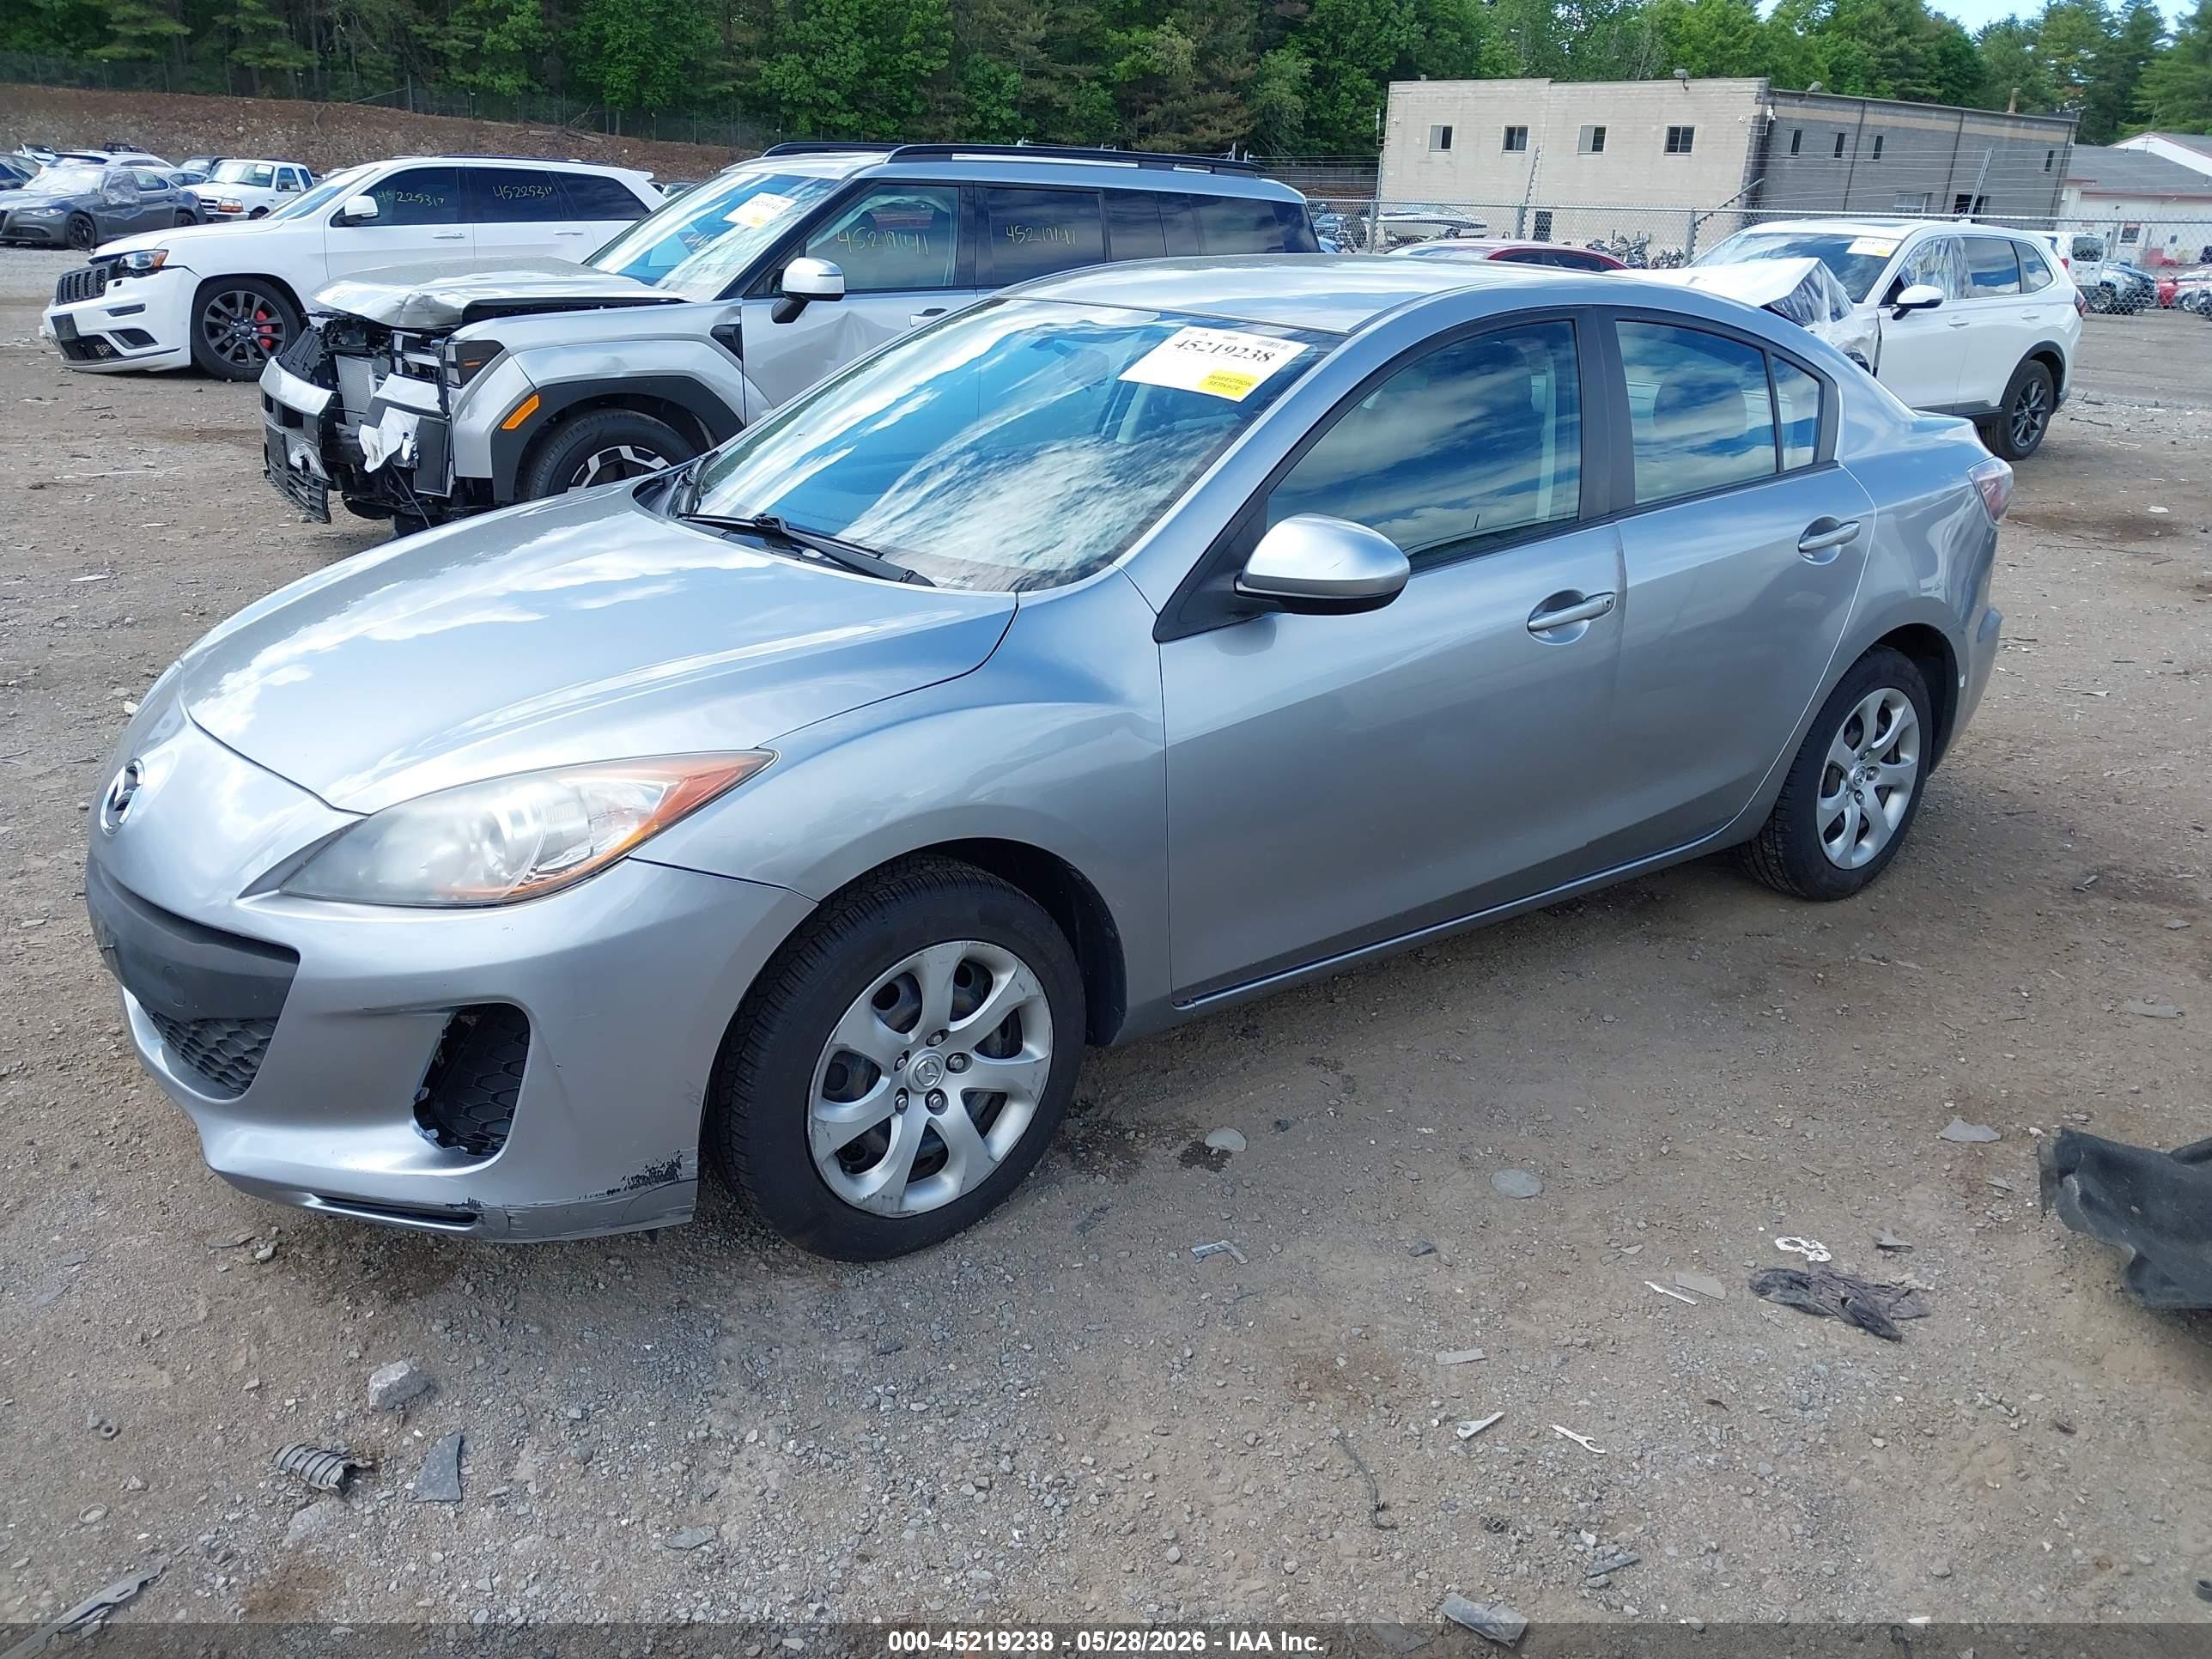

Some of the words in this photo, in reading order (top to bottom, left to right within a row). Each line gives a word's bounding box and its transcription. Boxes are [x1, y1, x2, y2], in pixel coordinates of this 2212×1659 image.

[492, 185, 553, 200] 45225317
[1175, 339, 1276, 362] 45219238
[1207, 380, 1241, 391] SERVICE
[1208, 374, 1253, 387] INSPECTION
